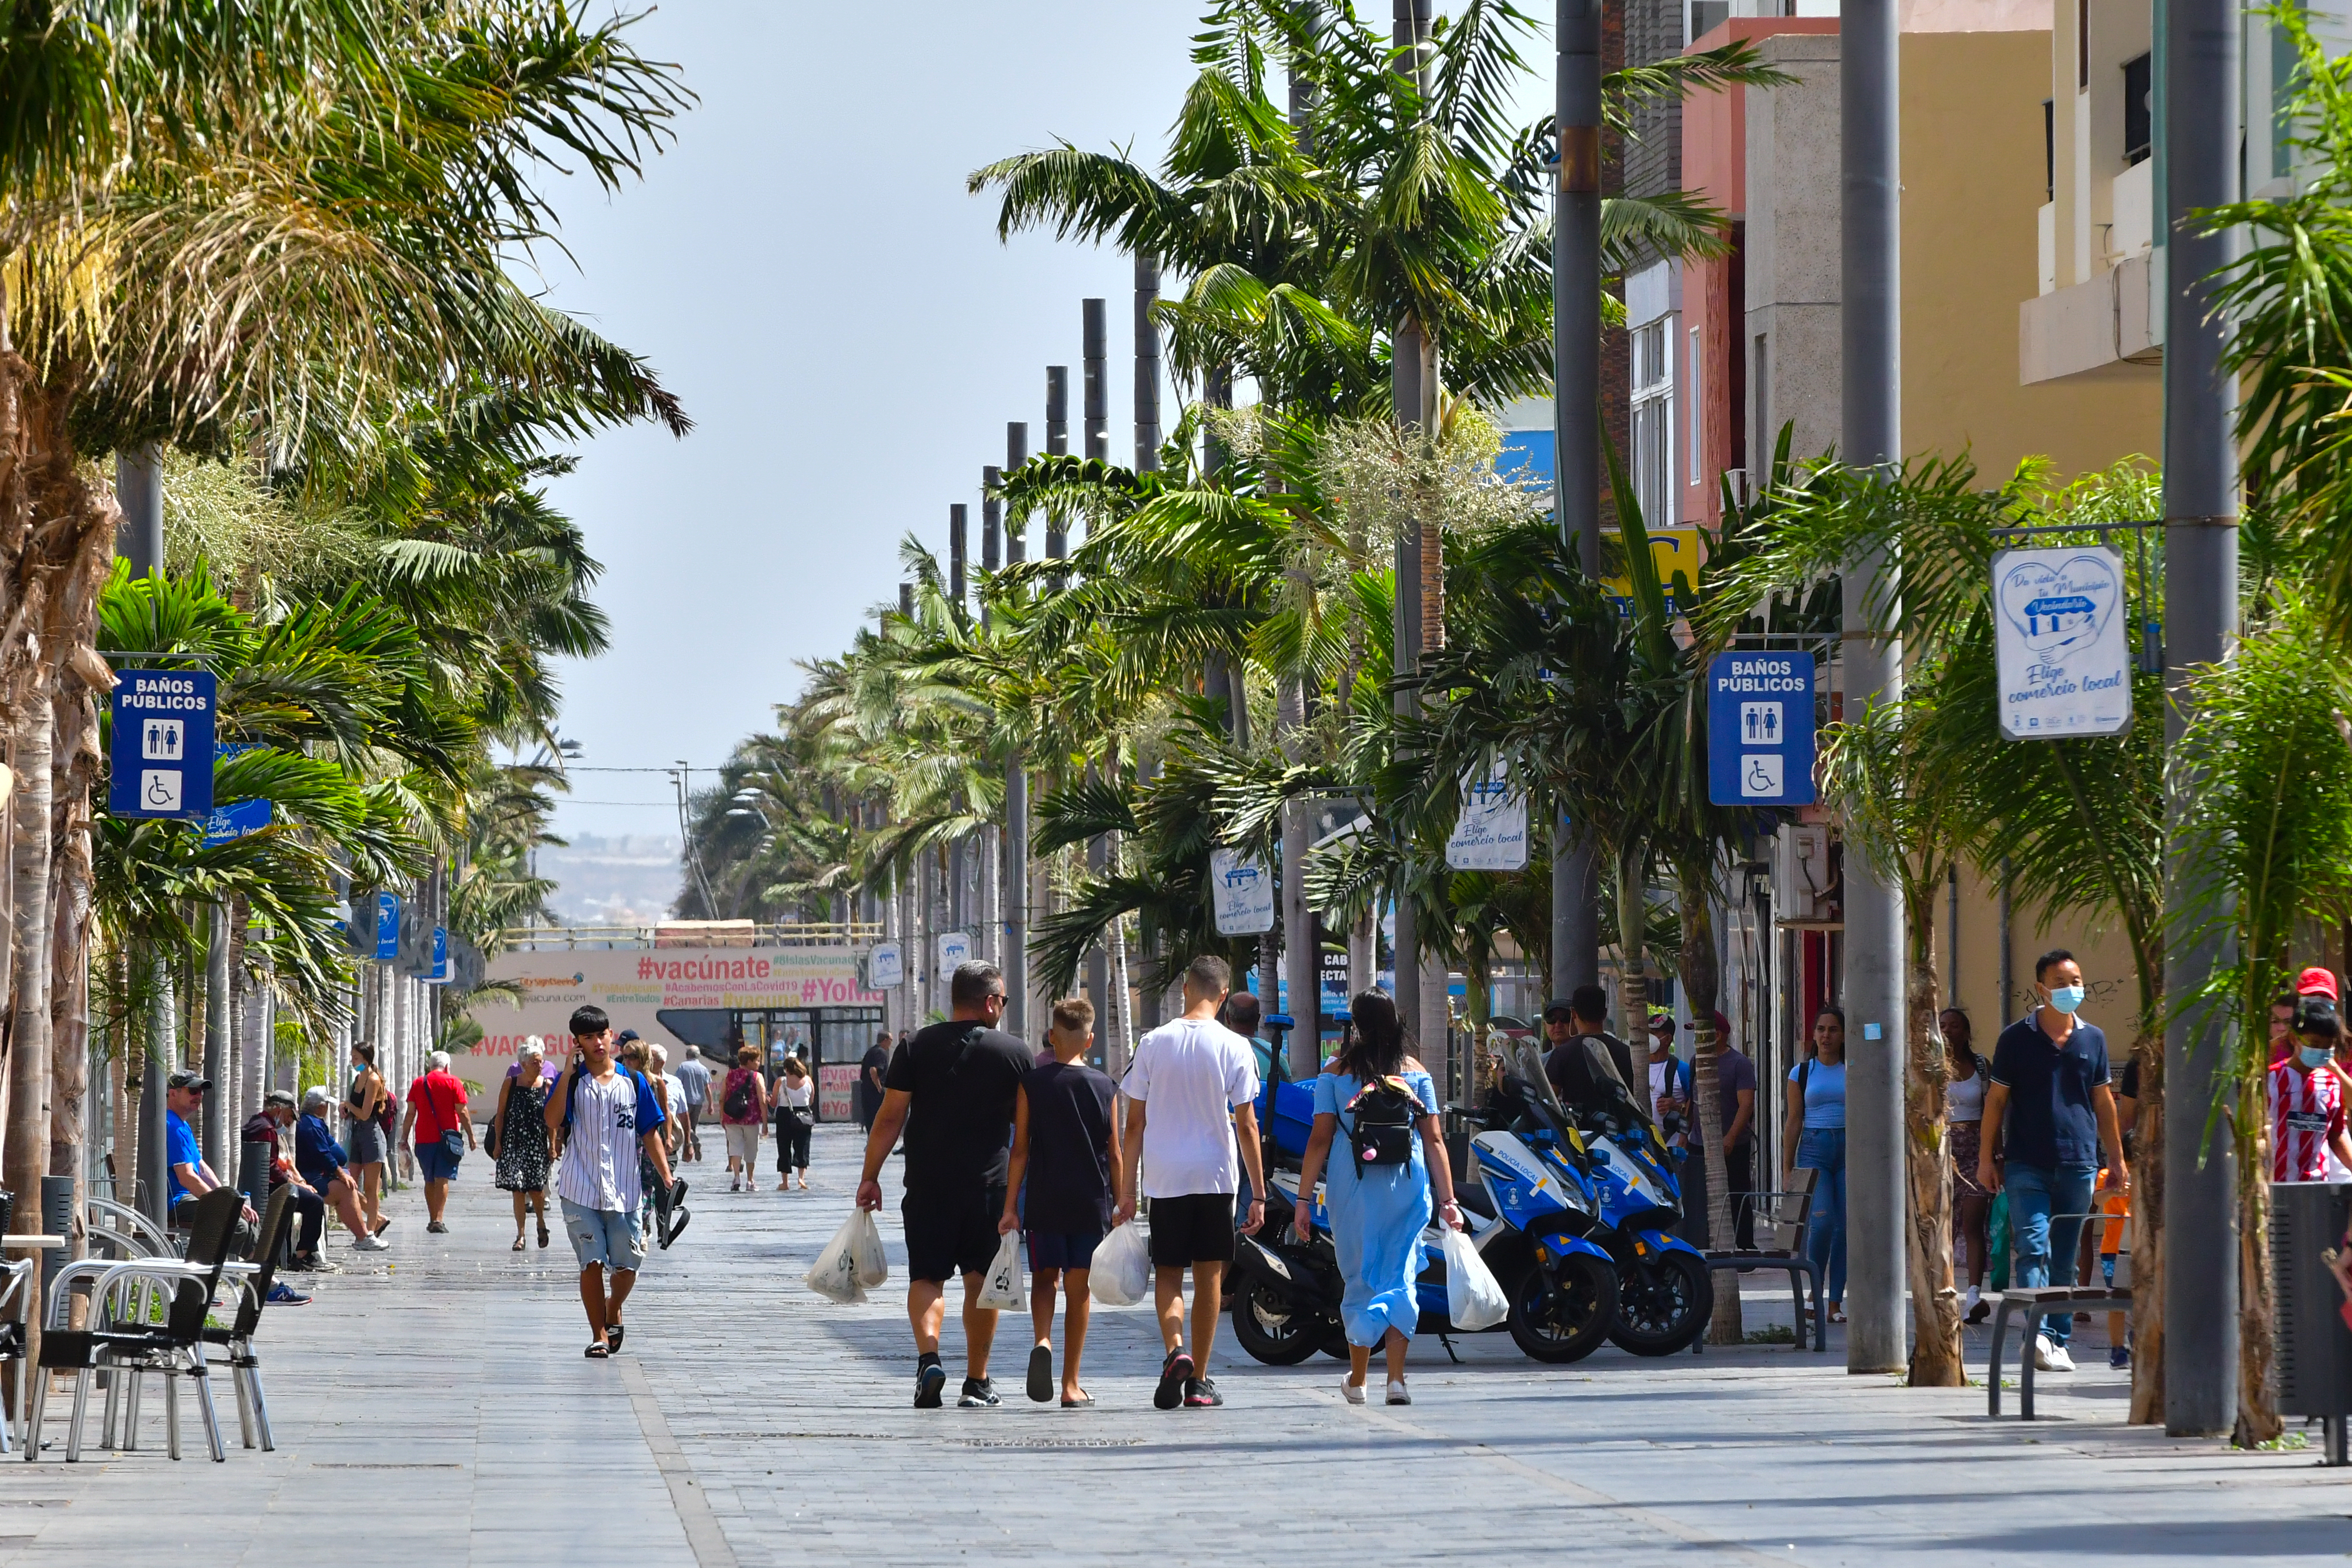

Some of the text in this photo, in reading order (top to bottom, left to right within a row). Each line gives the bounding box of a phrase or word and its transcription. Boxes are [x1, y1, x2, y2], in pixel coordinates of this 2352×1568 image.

[1731, 658, 1791, 675] BAÑOS
[2026, 664, 2064, 686] Elige
[136, 677, 193, 693] BAÑOS
[1718, 675, 1805, 692] PÚBLICOS
[2008, 670, 2122, 703] comercio local
[122, 692, 206, 710] PÚBLICOS
[207, 816, 231, 829] Elige
[1463, 823, 1488, 837] Elige
[1451, 831, 1522, 848] comercio local
[1219, 902, 1272, 920] comercio local
[1227, 900, 1246, 911] Elige
[638, 953, 770, 980] #vacúnate
[663, 995, 719, 1007] #Canarias
[723, 993, 800, 1008] #vacuna
[1498, 1150, 1538, 1182] POLICIA LOCAL
[1611, 1164, 1630, 1180] LOCAL
